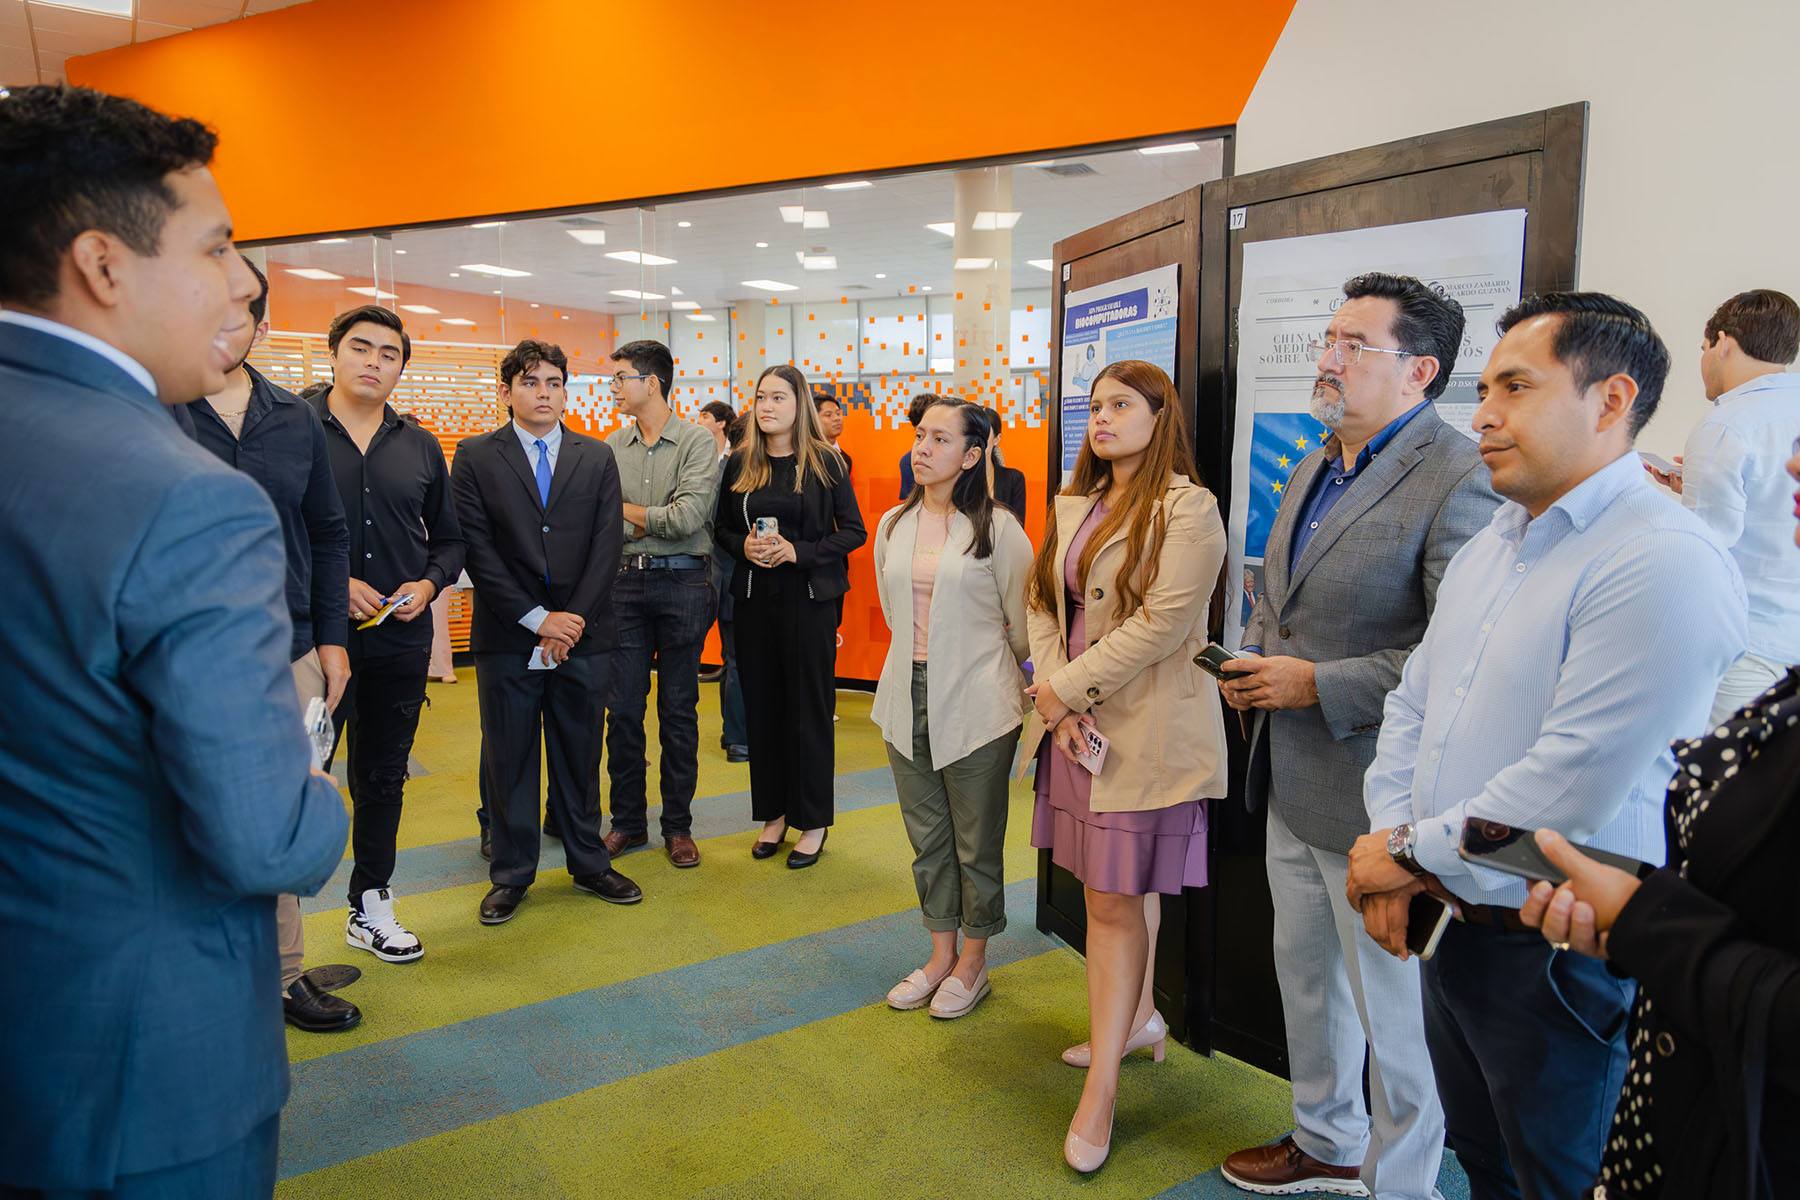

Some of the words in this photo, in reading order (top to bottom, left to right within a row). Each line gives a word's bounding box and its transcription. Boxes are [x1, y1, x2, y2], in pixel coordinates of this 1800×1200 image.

[1233, 213, 1243, 226] 17
[1446, 282, 1472, 290] MARCO
[1473, 280, 1510, 288] ZAMARIO
[1075, 304, 1138, 329] BIOCOMPUTADORAS
[1273, 333, 1312, 344] CHINA
[1259, 353, 1301, 364] SOBRE
